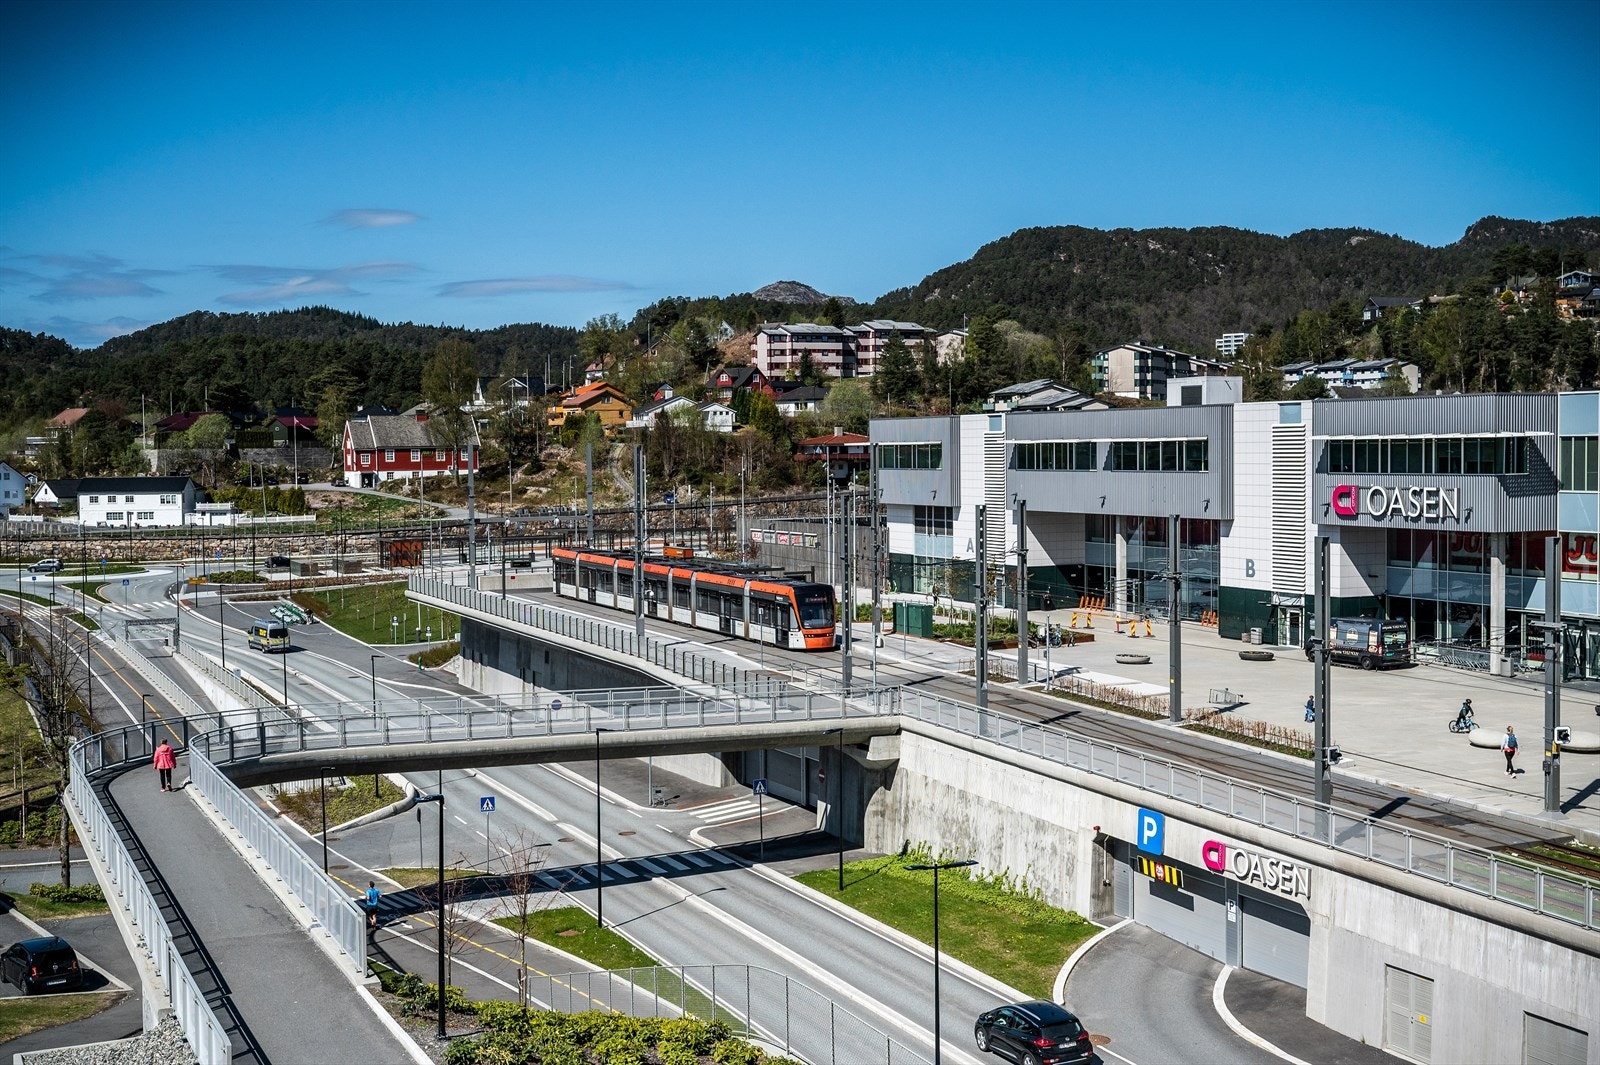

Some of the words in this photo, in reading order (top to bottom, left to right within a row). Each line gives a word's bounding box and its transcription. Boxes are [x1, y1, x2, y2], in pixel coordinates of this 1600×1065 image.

[1367, 485, 1458, 518] OASEN
[966, 537, 975, 553] A
[1245, 558, 1256, 578] B
[1143, 815, 1158, 845] P
[1232, 848, 1311, 898] OASEN
